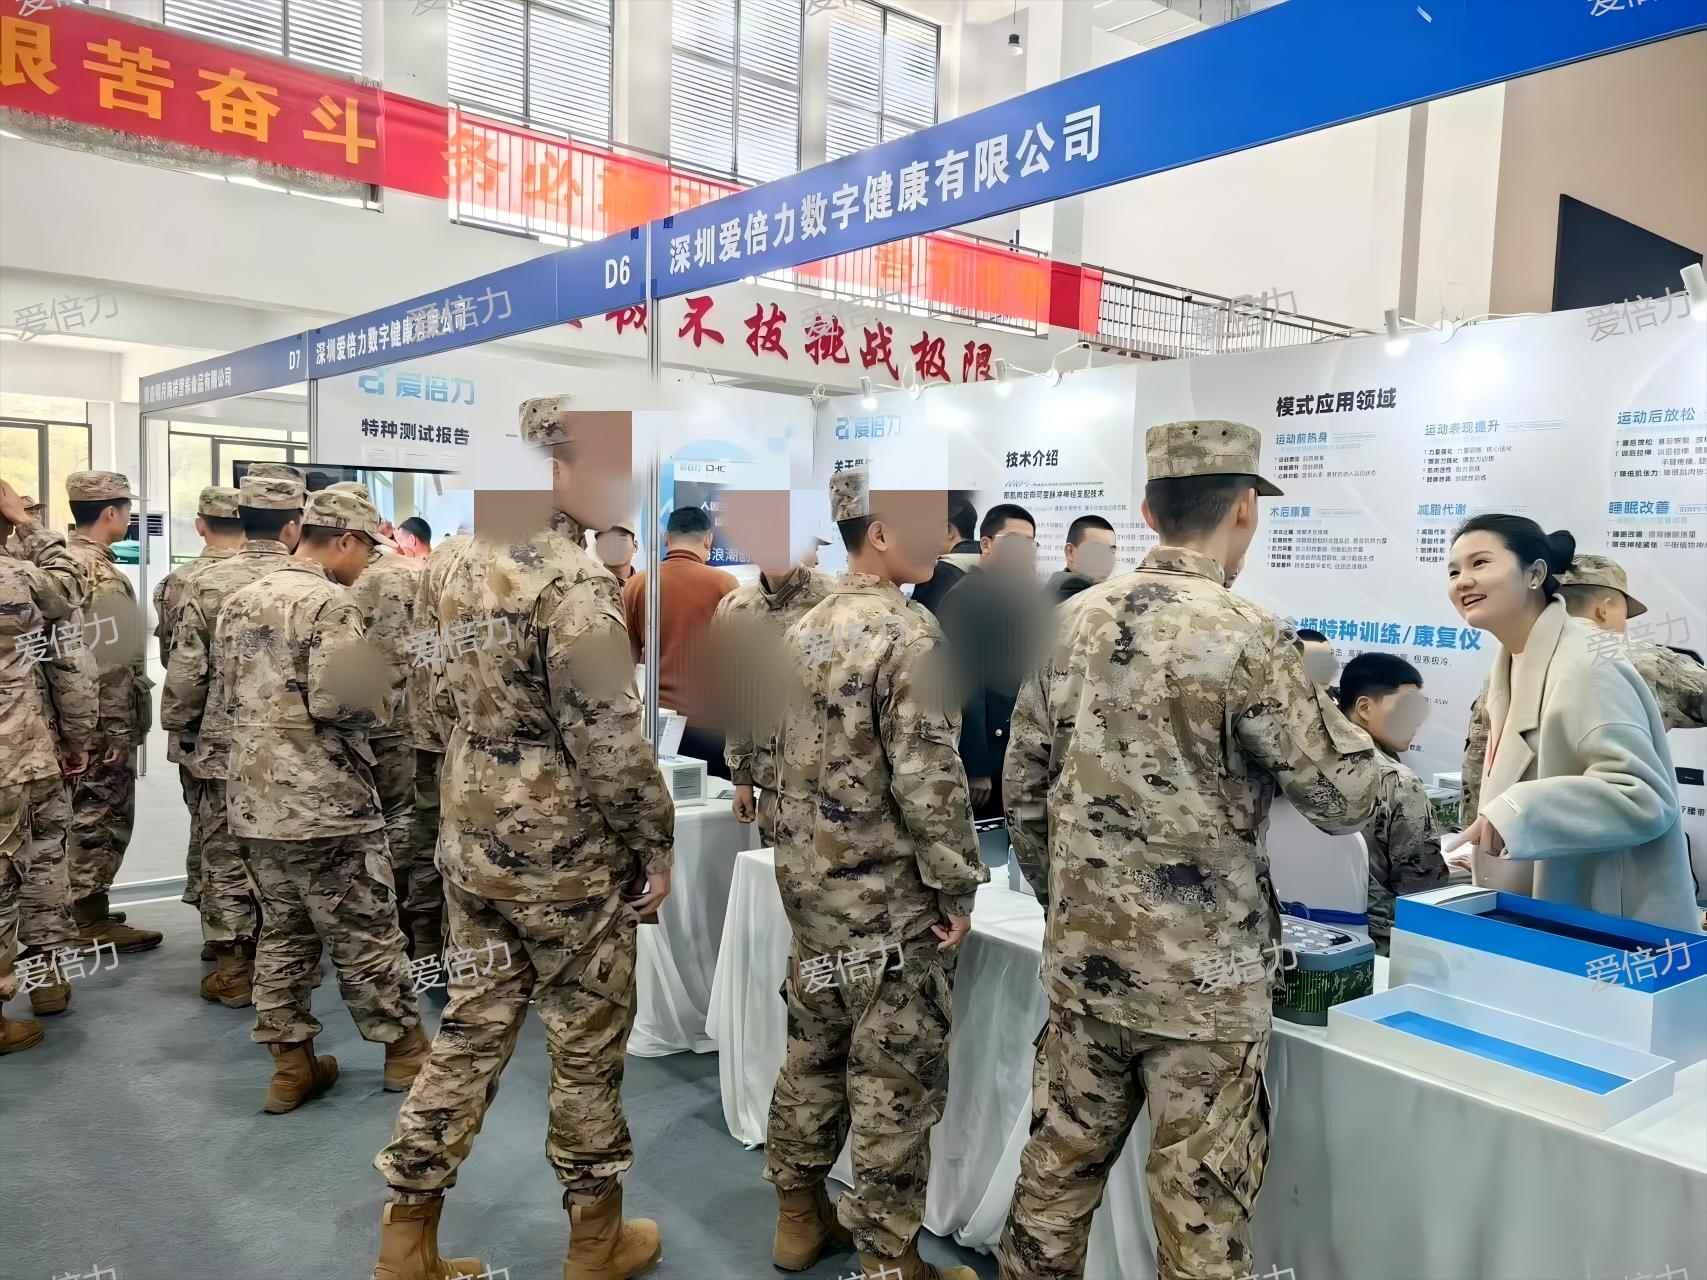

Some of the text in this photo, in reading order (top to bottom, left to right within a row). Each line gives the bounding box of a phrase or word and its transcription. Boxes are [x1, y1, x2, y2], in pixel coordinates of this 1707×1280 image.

[669, 105, 1103, 275] 深圳爱倍力数字健康有限公司
[605, 255, 631, 290] D6
[567, 296, 998, 383] 不拔挑战极限
[289, 350, 301, 370] D7
[1275, 387, 1397, 417] 模式应用领域
[1617, 407, 1696, 425] 运动后放松
[361, 418, 470, 446] 特种测试报告
[1424, 419, 1501, 436] 运动表现提升
[1275, 431, 1328, 445] 运动前热身
[1005, 449, 1059, 468] 技术介绍
[1270, 506, 1311, 518] 术后康复
[1417, 503, 1467, 516] 减脂代谢
[1608, 500, 1670, 515] 睡眠改善
[1291, 617, 1483, 651] 频特种训练/康复仪
